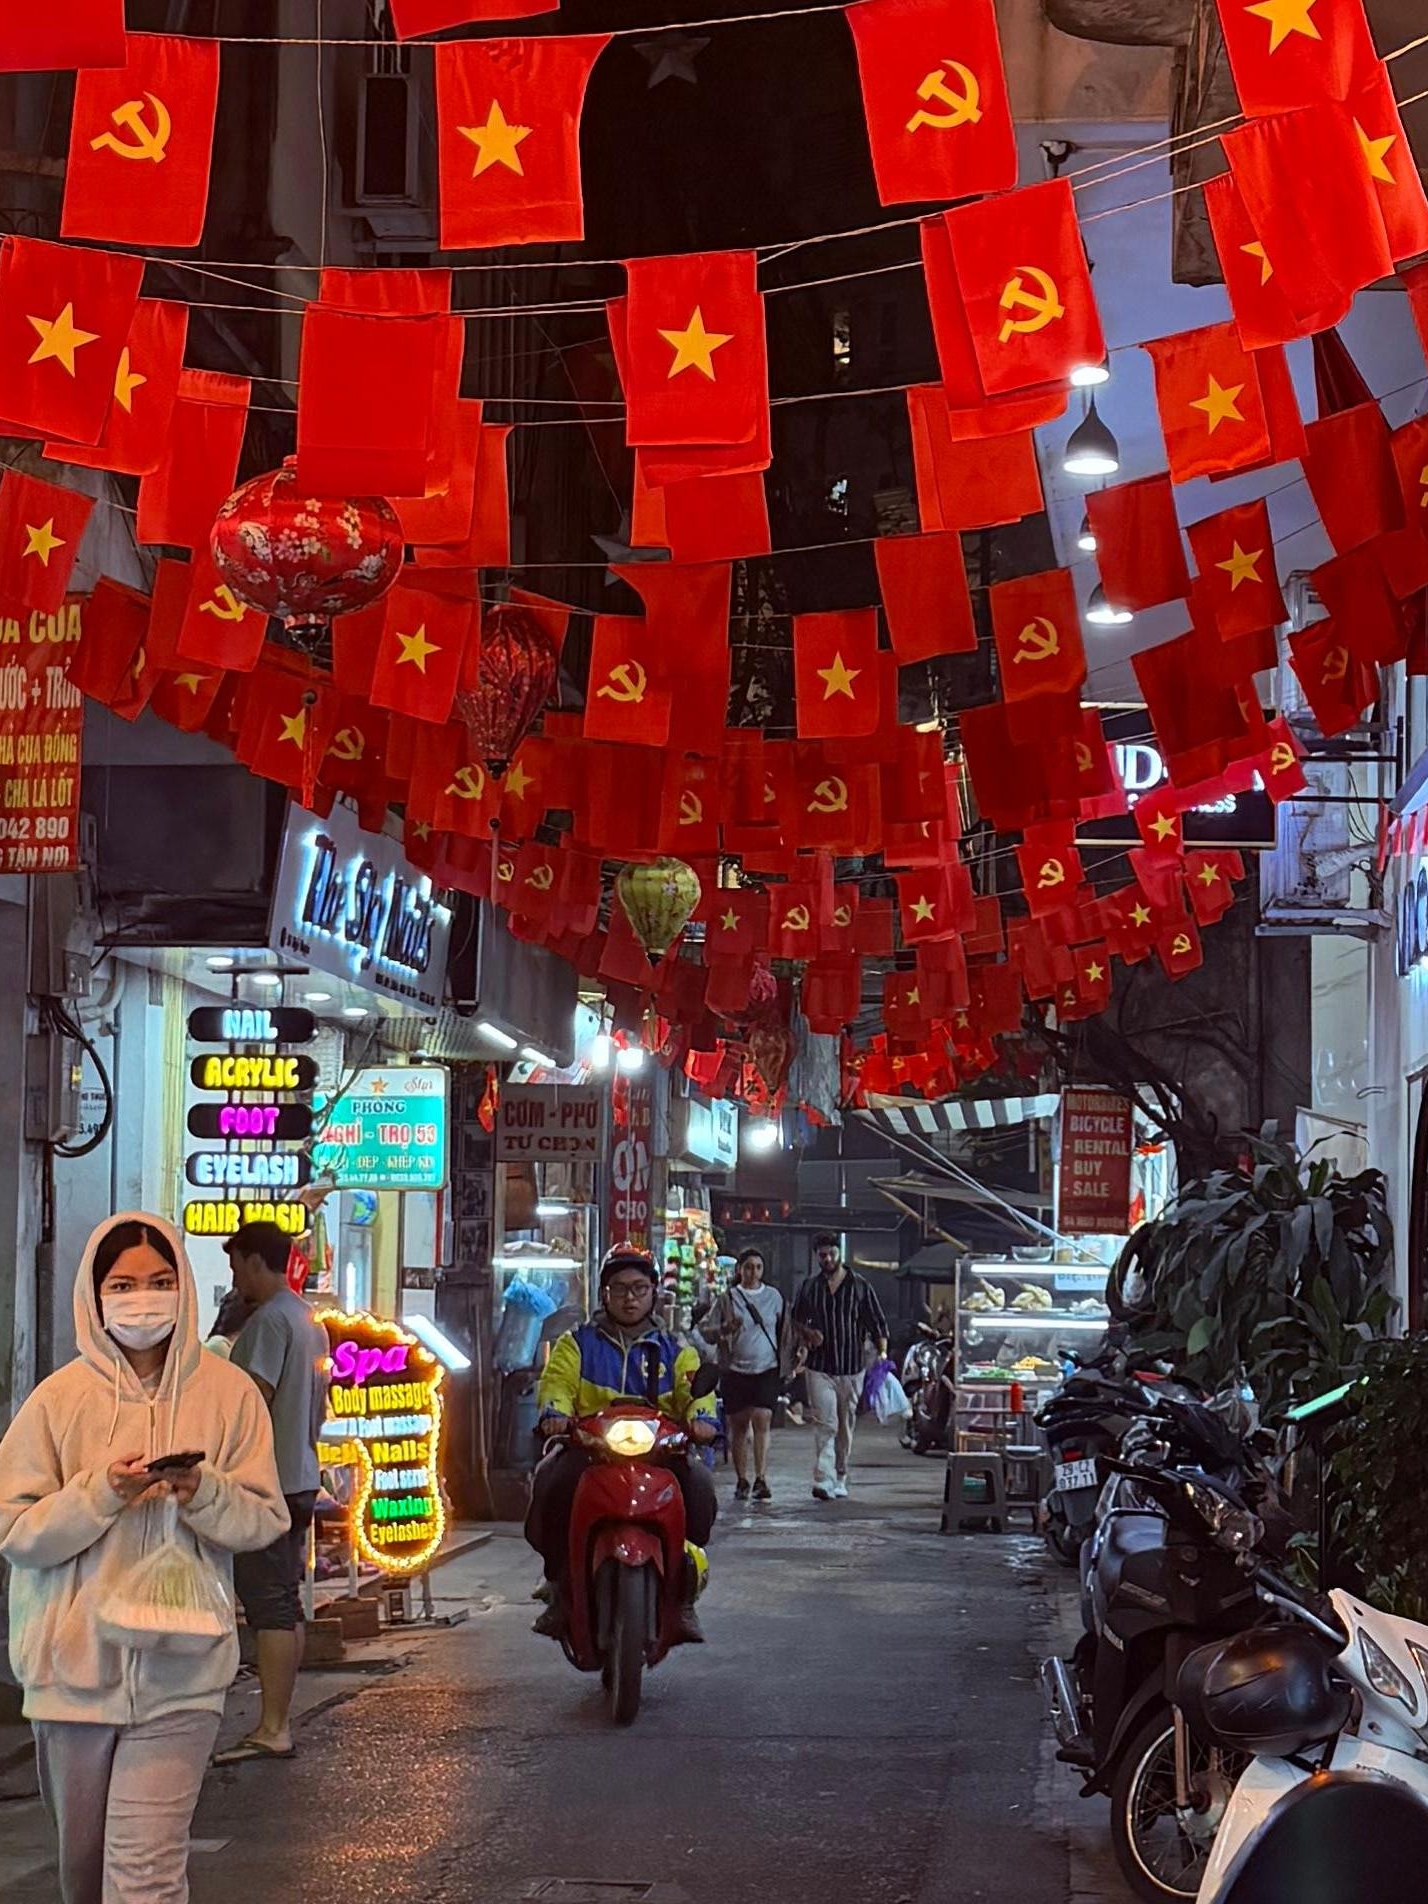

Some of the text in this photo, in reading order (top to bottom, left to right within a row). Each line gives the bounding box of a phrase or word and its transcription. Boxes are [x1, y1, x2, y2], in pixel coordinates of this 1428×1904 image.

[18, 736, 41, 763] CUA
[35, 817, 69, 840] 890
[222, 1009, 277, 1039] NAIL
[204, 1057, 299, 1088] ACRYLIC
[220, 1107, 279, 1134] FOOT
[504, 1099, 545, 1128] CƠM
[1070, 1115, 1125, 1133] BICYCLE
[1074, 1139, 1128, 1155] RENTAL
[196, 1155, 299, 1185] EYELASH
[1073, 1160, 1103, 1176] BUY
[1072, 1181, 1111, 1197] SALE
[186, 1203, 240, 1233] HAIR
[332, 1341, 408, 1384] Spa
[331, 1381, 430, 1415] Body massage
[372, 1440, 429, 1464] Nails
[371, 1496, 433, 1520] Waxing
[370, 1520, 434, 1545] Eyelashes
